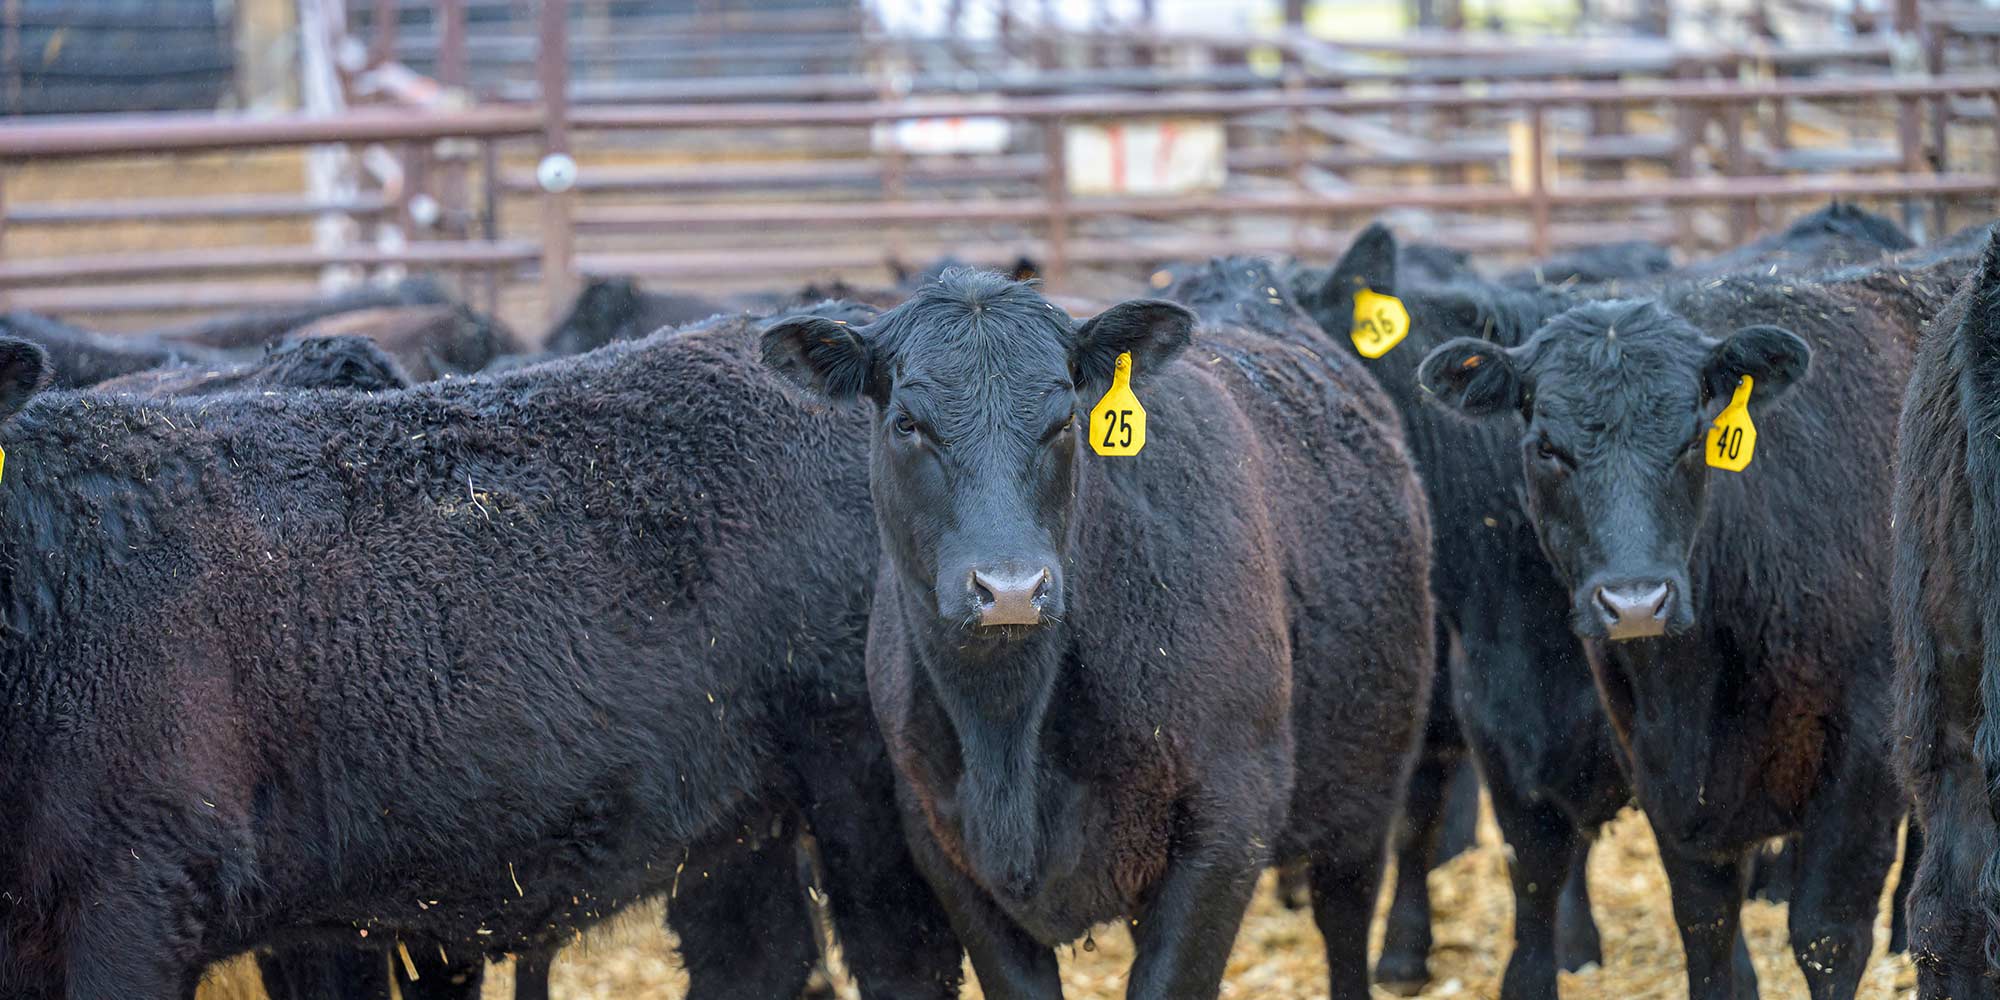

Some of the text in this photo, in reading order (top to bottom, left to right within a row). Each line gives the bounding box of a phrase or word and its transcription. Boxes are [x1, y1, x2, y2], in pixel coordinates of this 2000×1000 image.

[1359, 308, 1394, 343] 36
[1103, 409, 1133, 447] 25
[1717, 424, 1743, 460] 40
